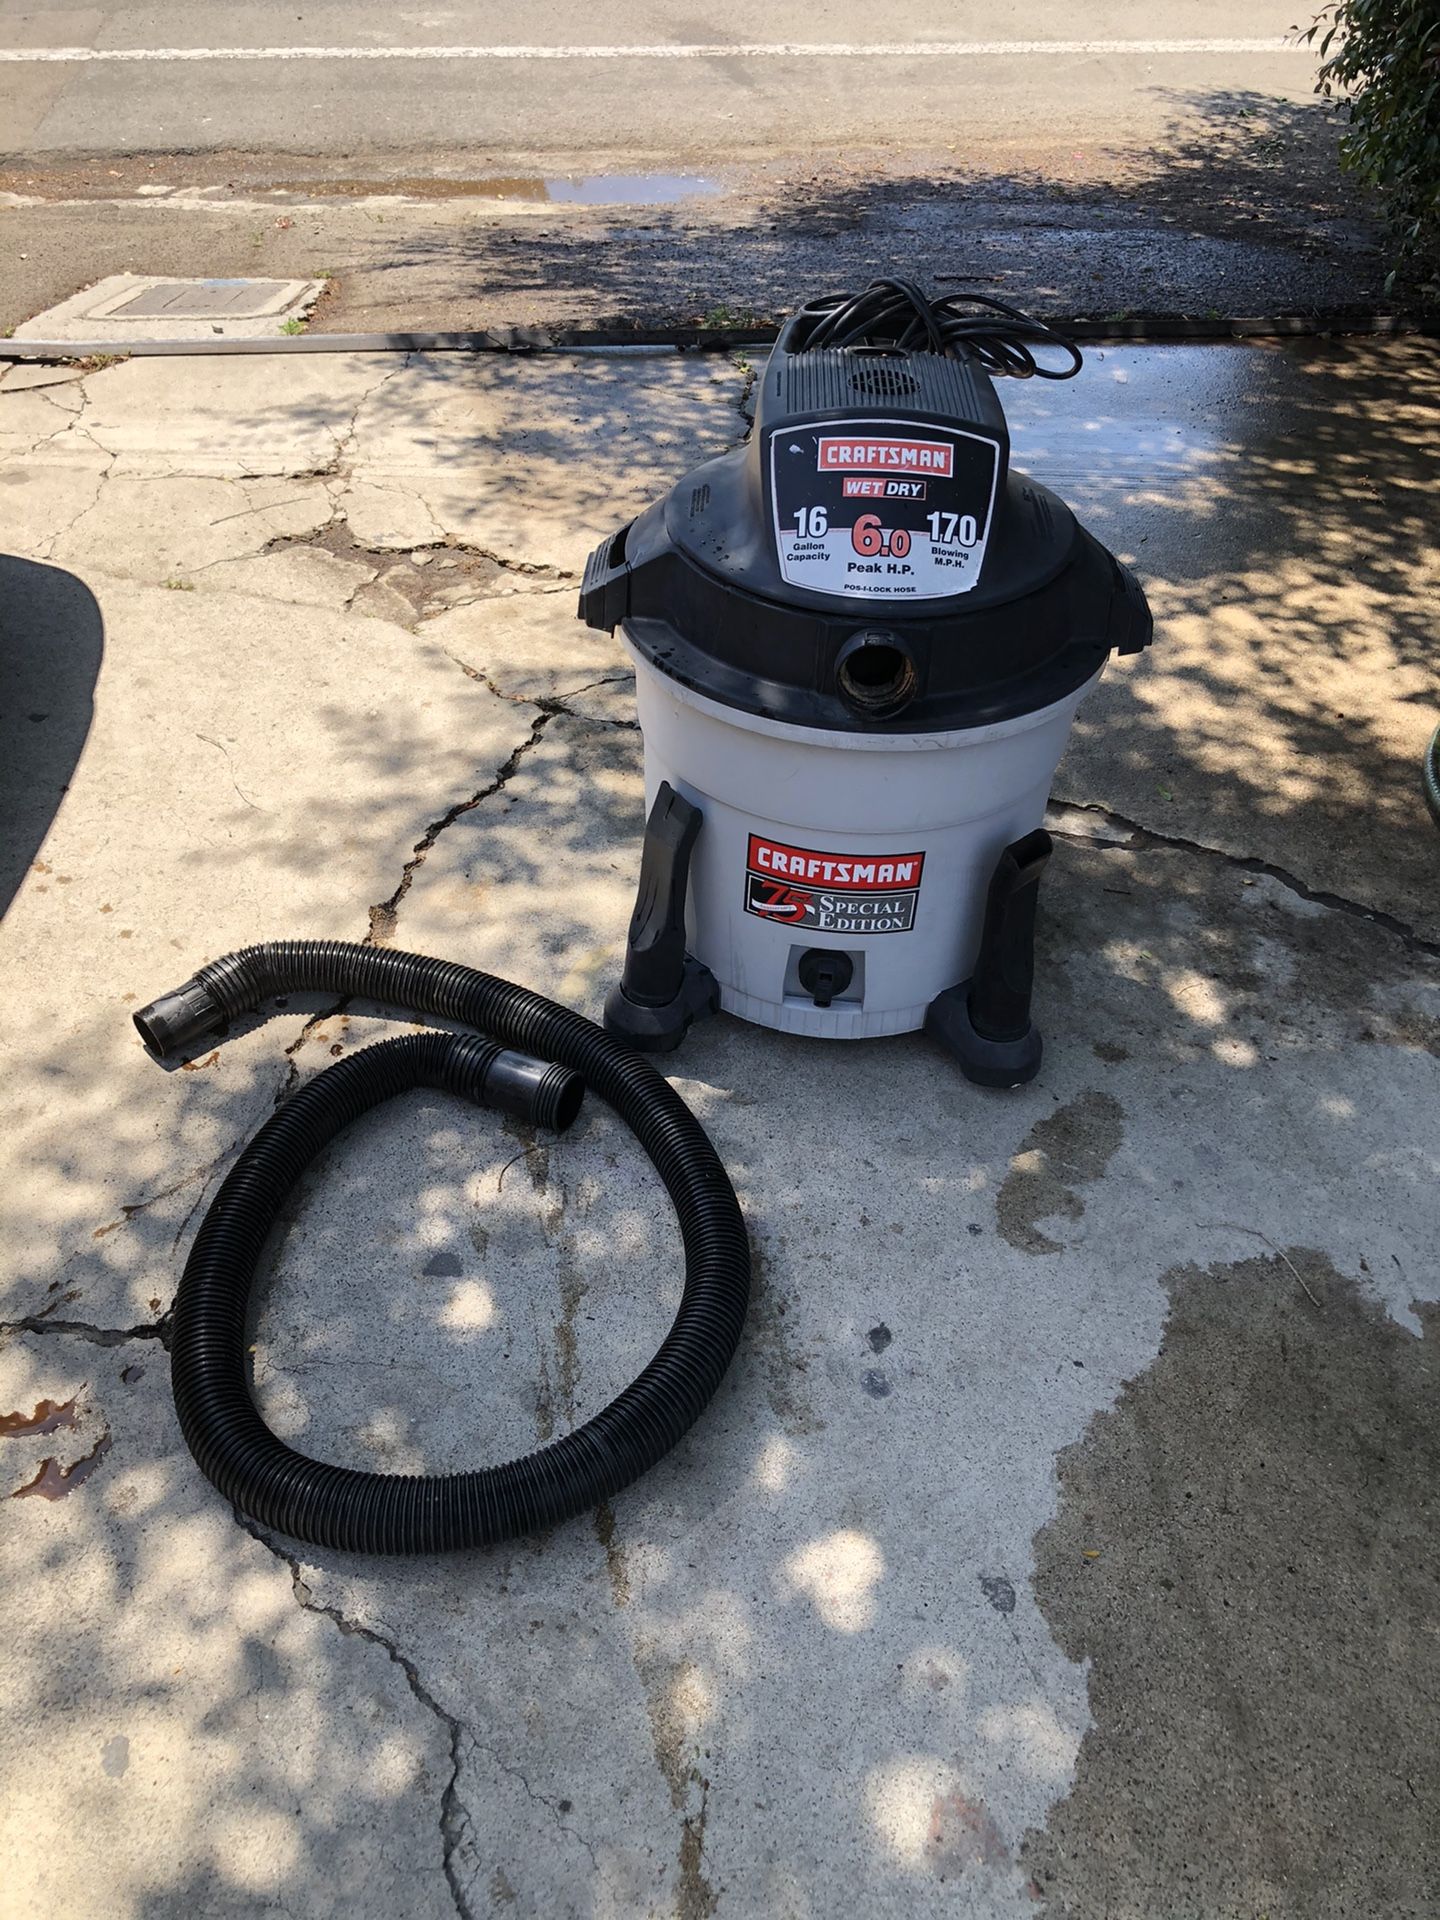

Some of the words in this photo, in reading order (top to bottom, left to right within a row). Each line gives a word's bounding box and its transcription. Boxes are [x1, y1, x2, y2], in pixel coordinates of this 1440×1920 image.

[826, 445, 945, 469] CRAFTSMAN
[846, 481, 883, 495] WET
[886, 480, 922, 497] DRY
[793, 506, 828, 538] 16
[926, 510, 977, 548] 170
[851, 512, 911, 558] 6.0
[793, 542, 825, 551] Gallon
[931, 547, 969, 560] Blowing
[786, 552, 831, 562] Capacity
[934, 558, 965, 568] M.P.H.
[847, 562, 882, 574] Peak
[887, 563, 915, 576] H.P.
[757, 846, 913, 884] CRAFTSMAN
